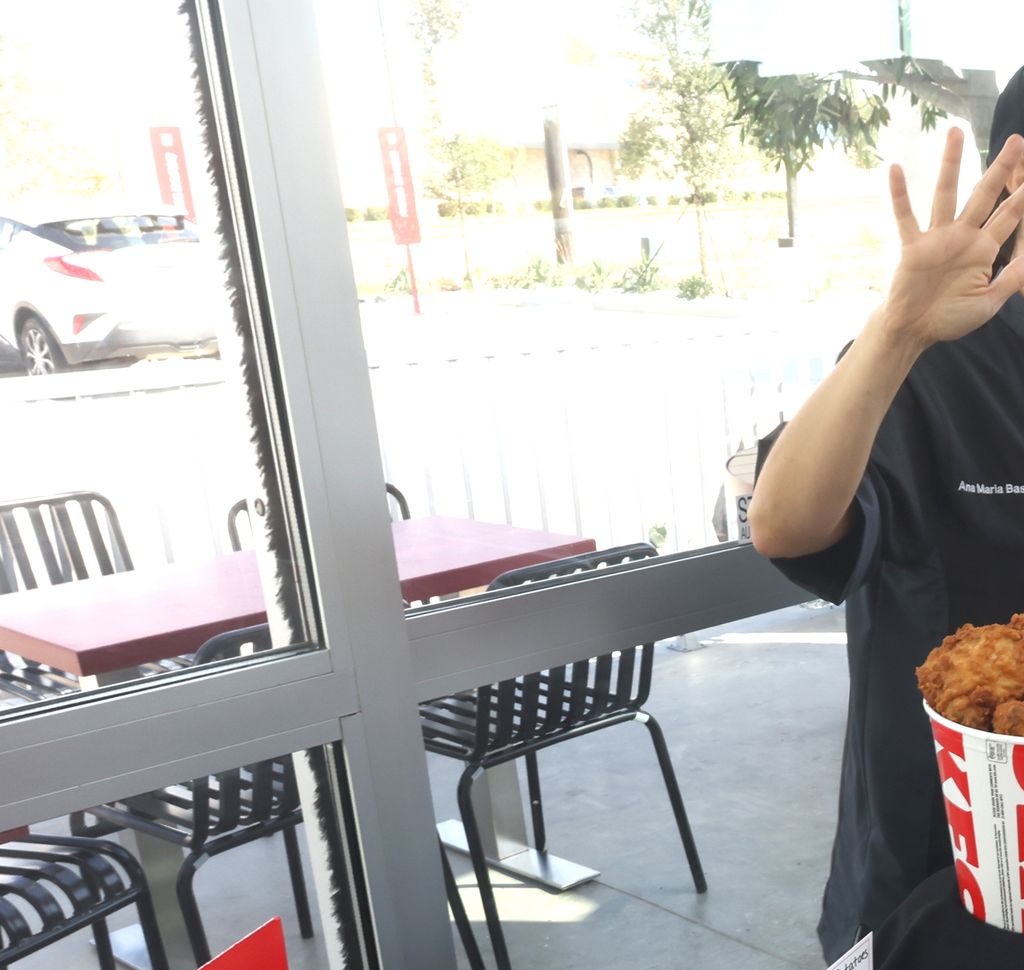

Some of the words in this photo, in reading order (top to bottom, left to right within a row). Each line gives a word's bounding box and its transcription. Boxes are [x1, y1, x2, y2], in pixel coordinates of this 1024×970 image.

[958, 480, 976, 493] Ana
[976, 483, 1003, 494] Maria
[930, 718, 987, 923] KFC
